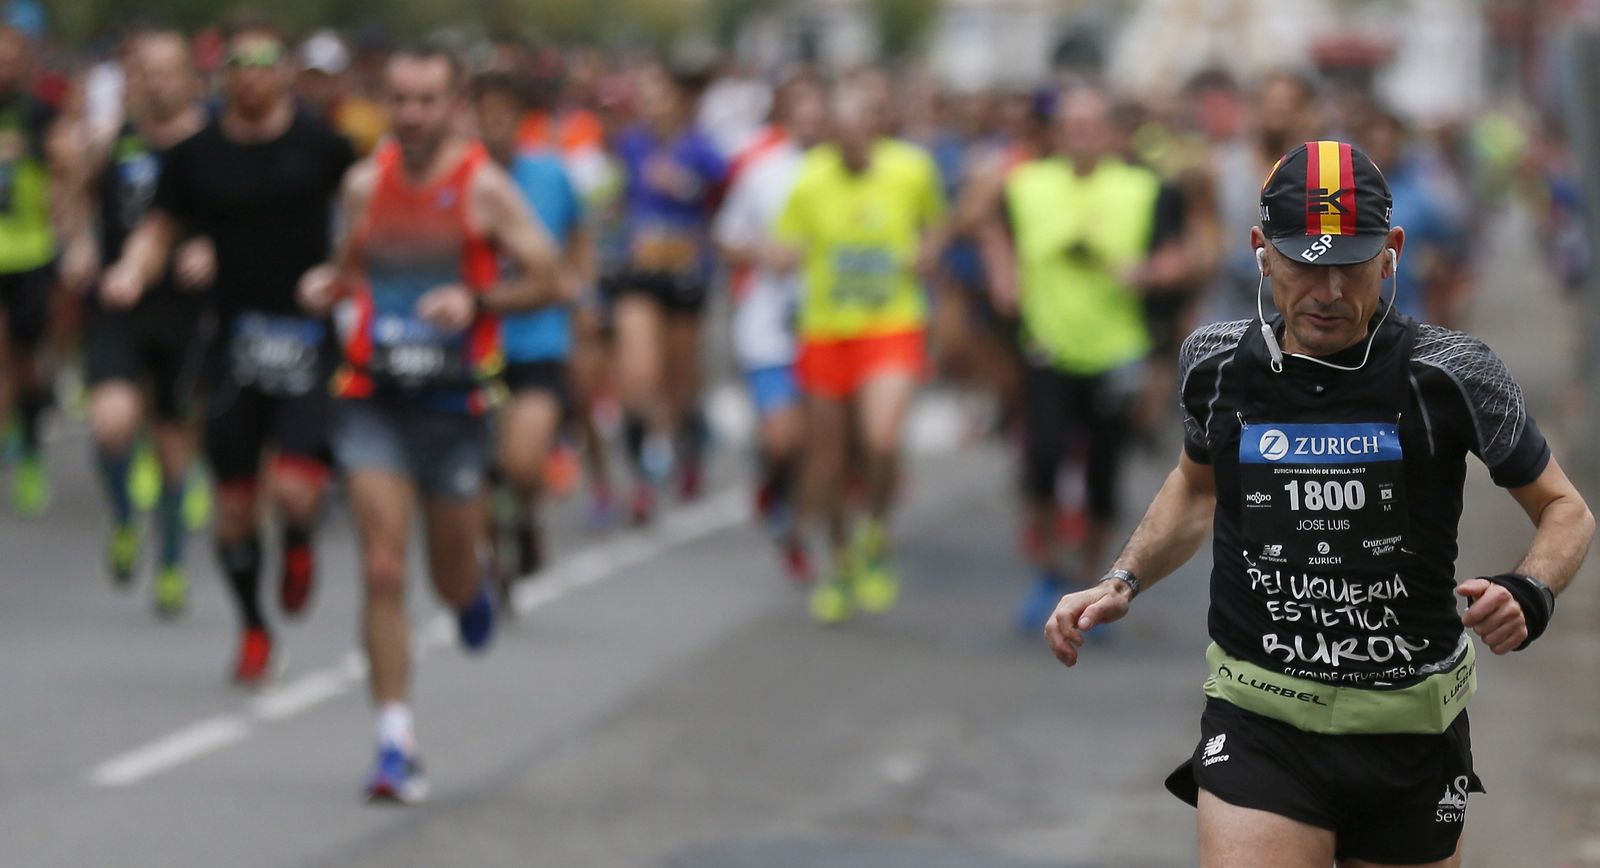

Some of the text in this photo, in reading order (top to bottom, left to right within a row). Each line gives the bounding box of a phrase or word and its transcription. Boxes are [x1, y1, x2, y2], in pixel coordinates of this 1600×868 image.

[1301, 234, 1333, 262] ESP
[1294, 436, 1379, 455] ZURICH
[1294, 467, 1320, 475] MARATÓN
[1284, 480, 1366, 511] 1800
[1296, 519, 1350, 531] JOSE LUIS
[1362, 535, 1402, 548] Cruzcampo
[1308, 556, 1342, 565] ZURICH
[1267, 601, 1399, 631] ESTETICA
[1262, 632, 1430, 667] BURON
[1408, 664, 1416, 675] 6
[1237, 674, 1327, 706] LURBEL
[1435, 808, 1465, 823] Sevi
